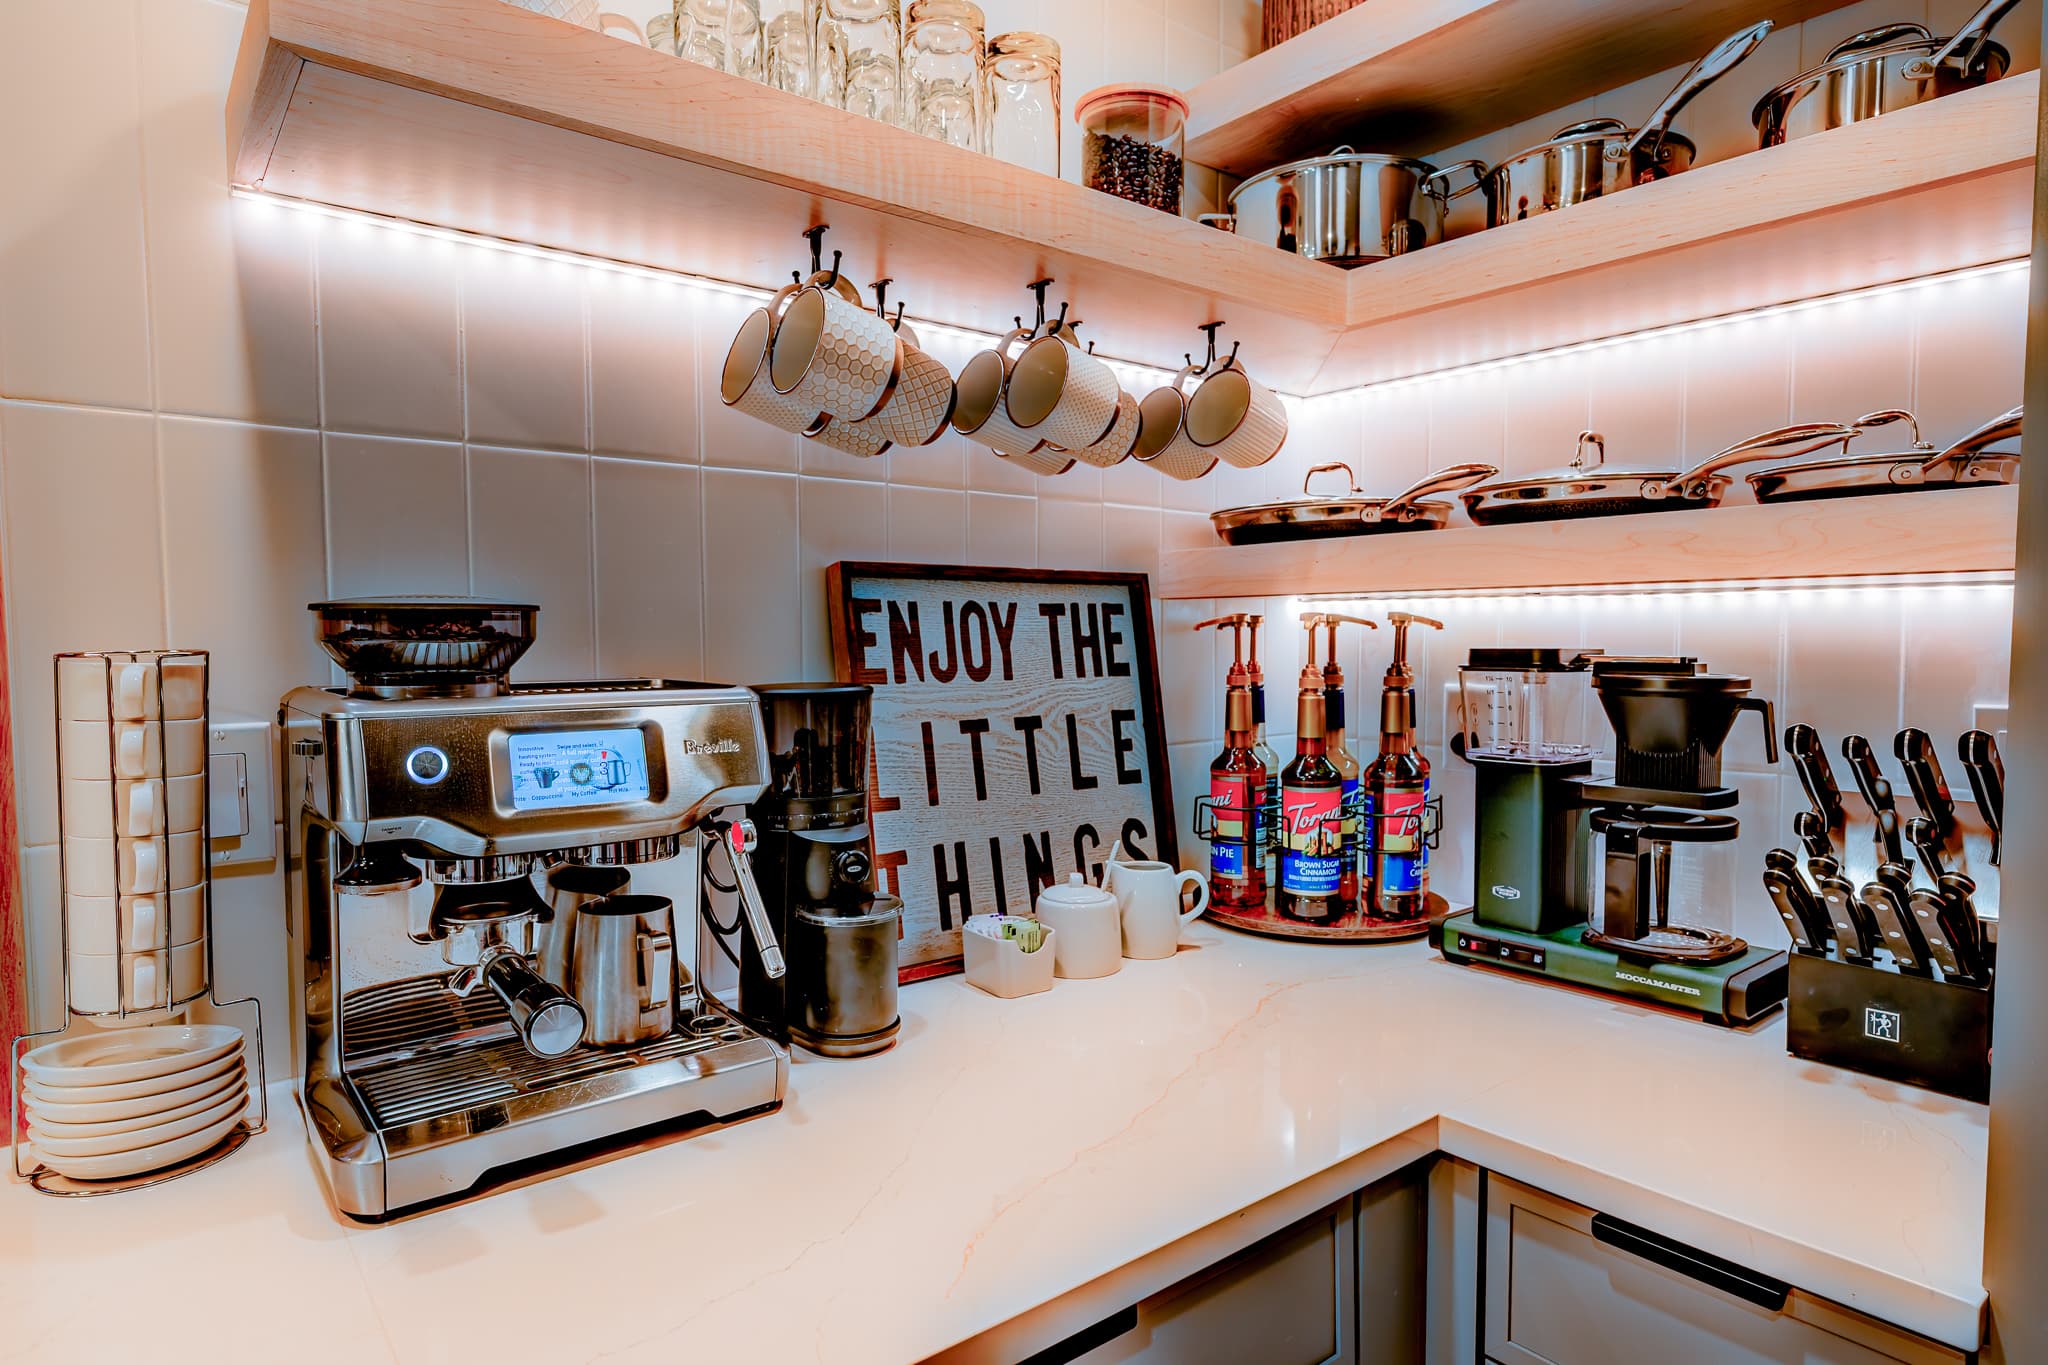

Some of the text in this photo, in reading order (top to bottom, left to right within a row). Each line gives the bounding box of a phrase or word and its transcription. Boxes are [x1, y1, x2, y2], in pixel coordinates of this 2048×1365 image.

[852, 598, 1131, 685] ENJOY THE
[683, 738, 740, 755] Breville
[1219, 846, 1235, 859] PIE
[1294, 859, 1321, 869] BROWN
[1300, 868, 1337, 876] CINNAMON
[1615, 971, 1701, 997] MOCCAMASTER
